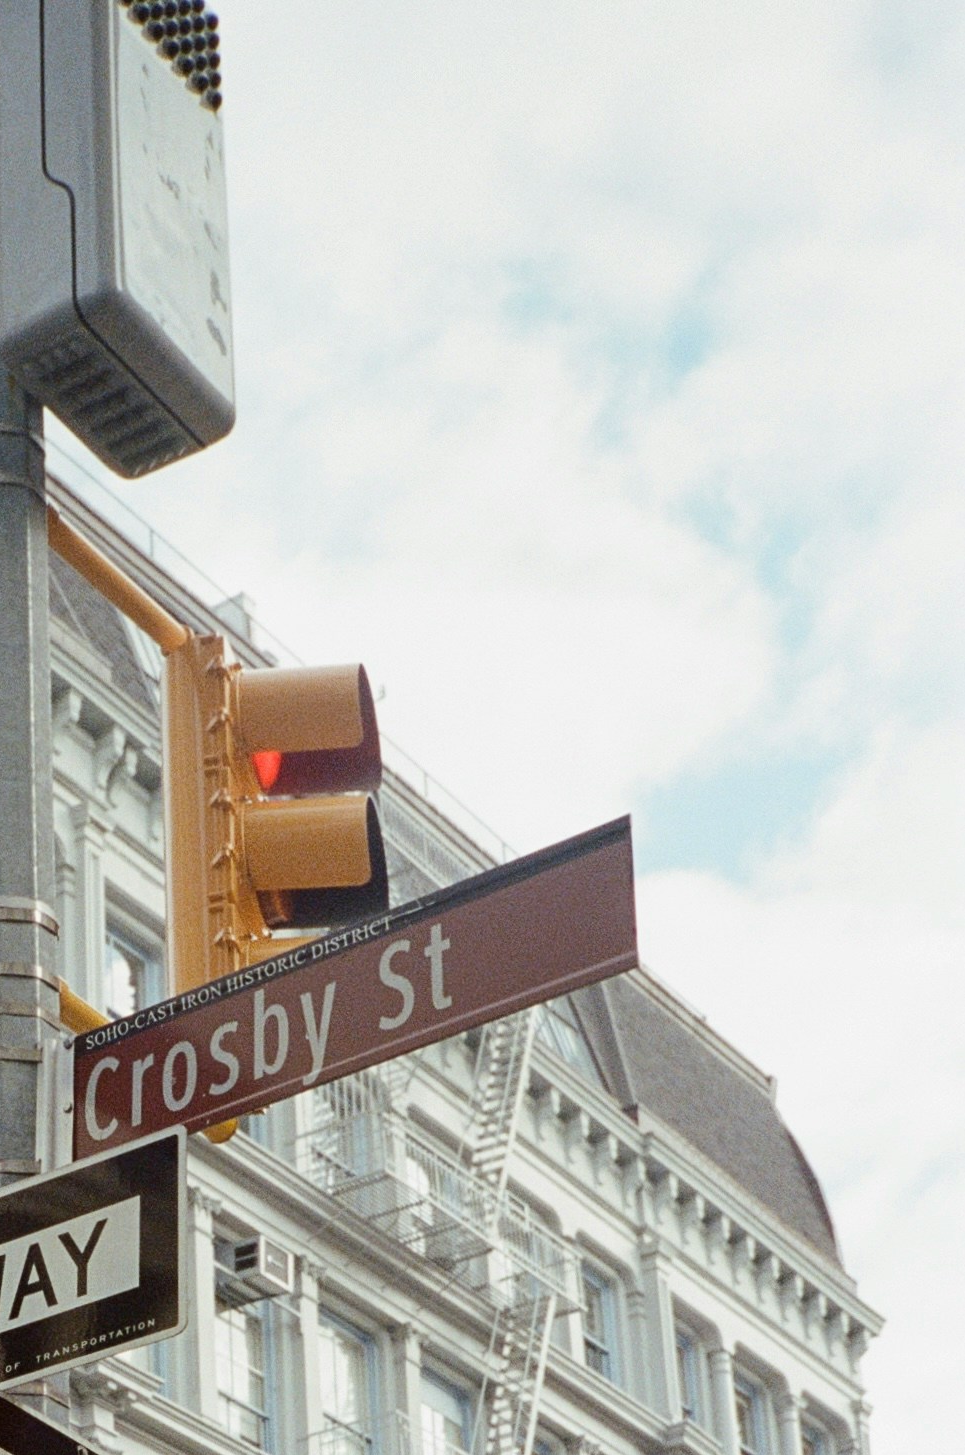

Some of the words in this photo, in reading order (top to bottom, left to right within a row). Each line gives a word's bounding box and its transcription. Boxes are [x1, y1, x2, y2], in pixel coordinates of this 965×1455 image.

[84, 981, 337, 1141] Crosby
[378, 923, 453, 1030] St
[86, 1002, 177, 1050] SOHO-CAST
[181, 985, 222, 1012] IRON
[227, 950, 307, 994] HISTORIC
[312, 915, 394, 959] DISTRICT
[5, 1361, 21, 1373] OF
[36, 1318, 156, 1363] TRANSPORTATION
